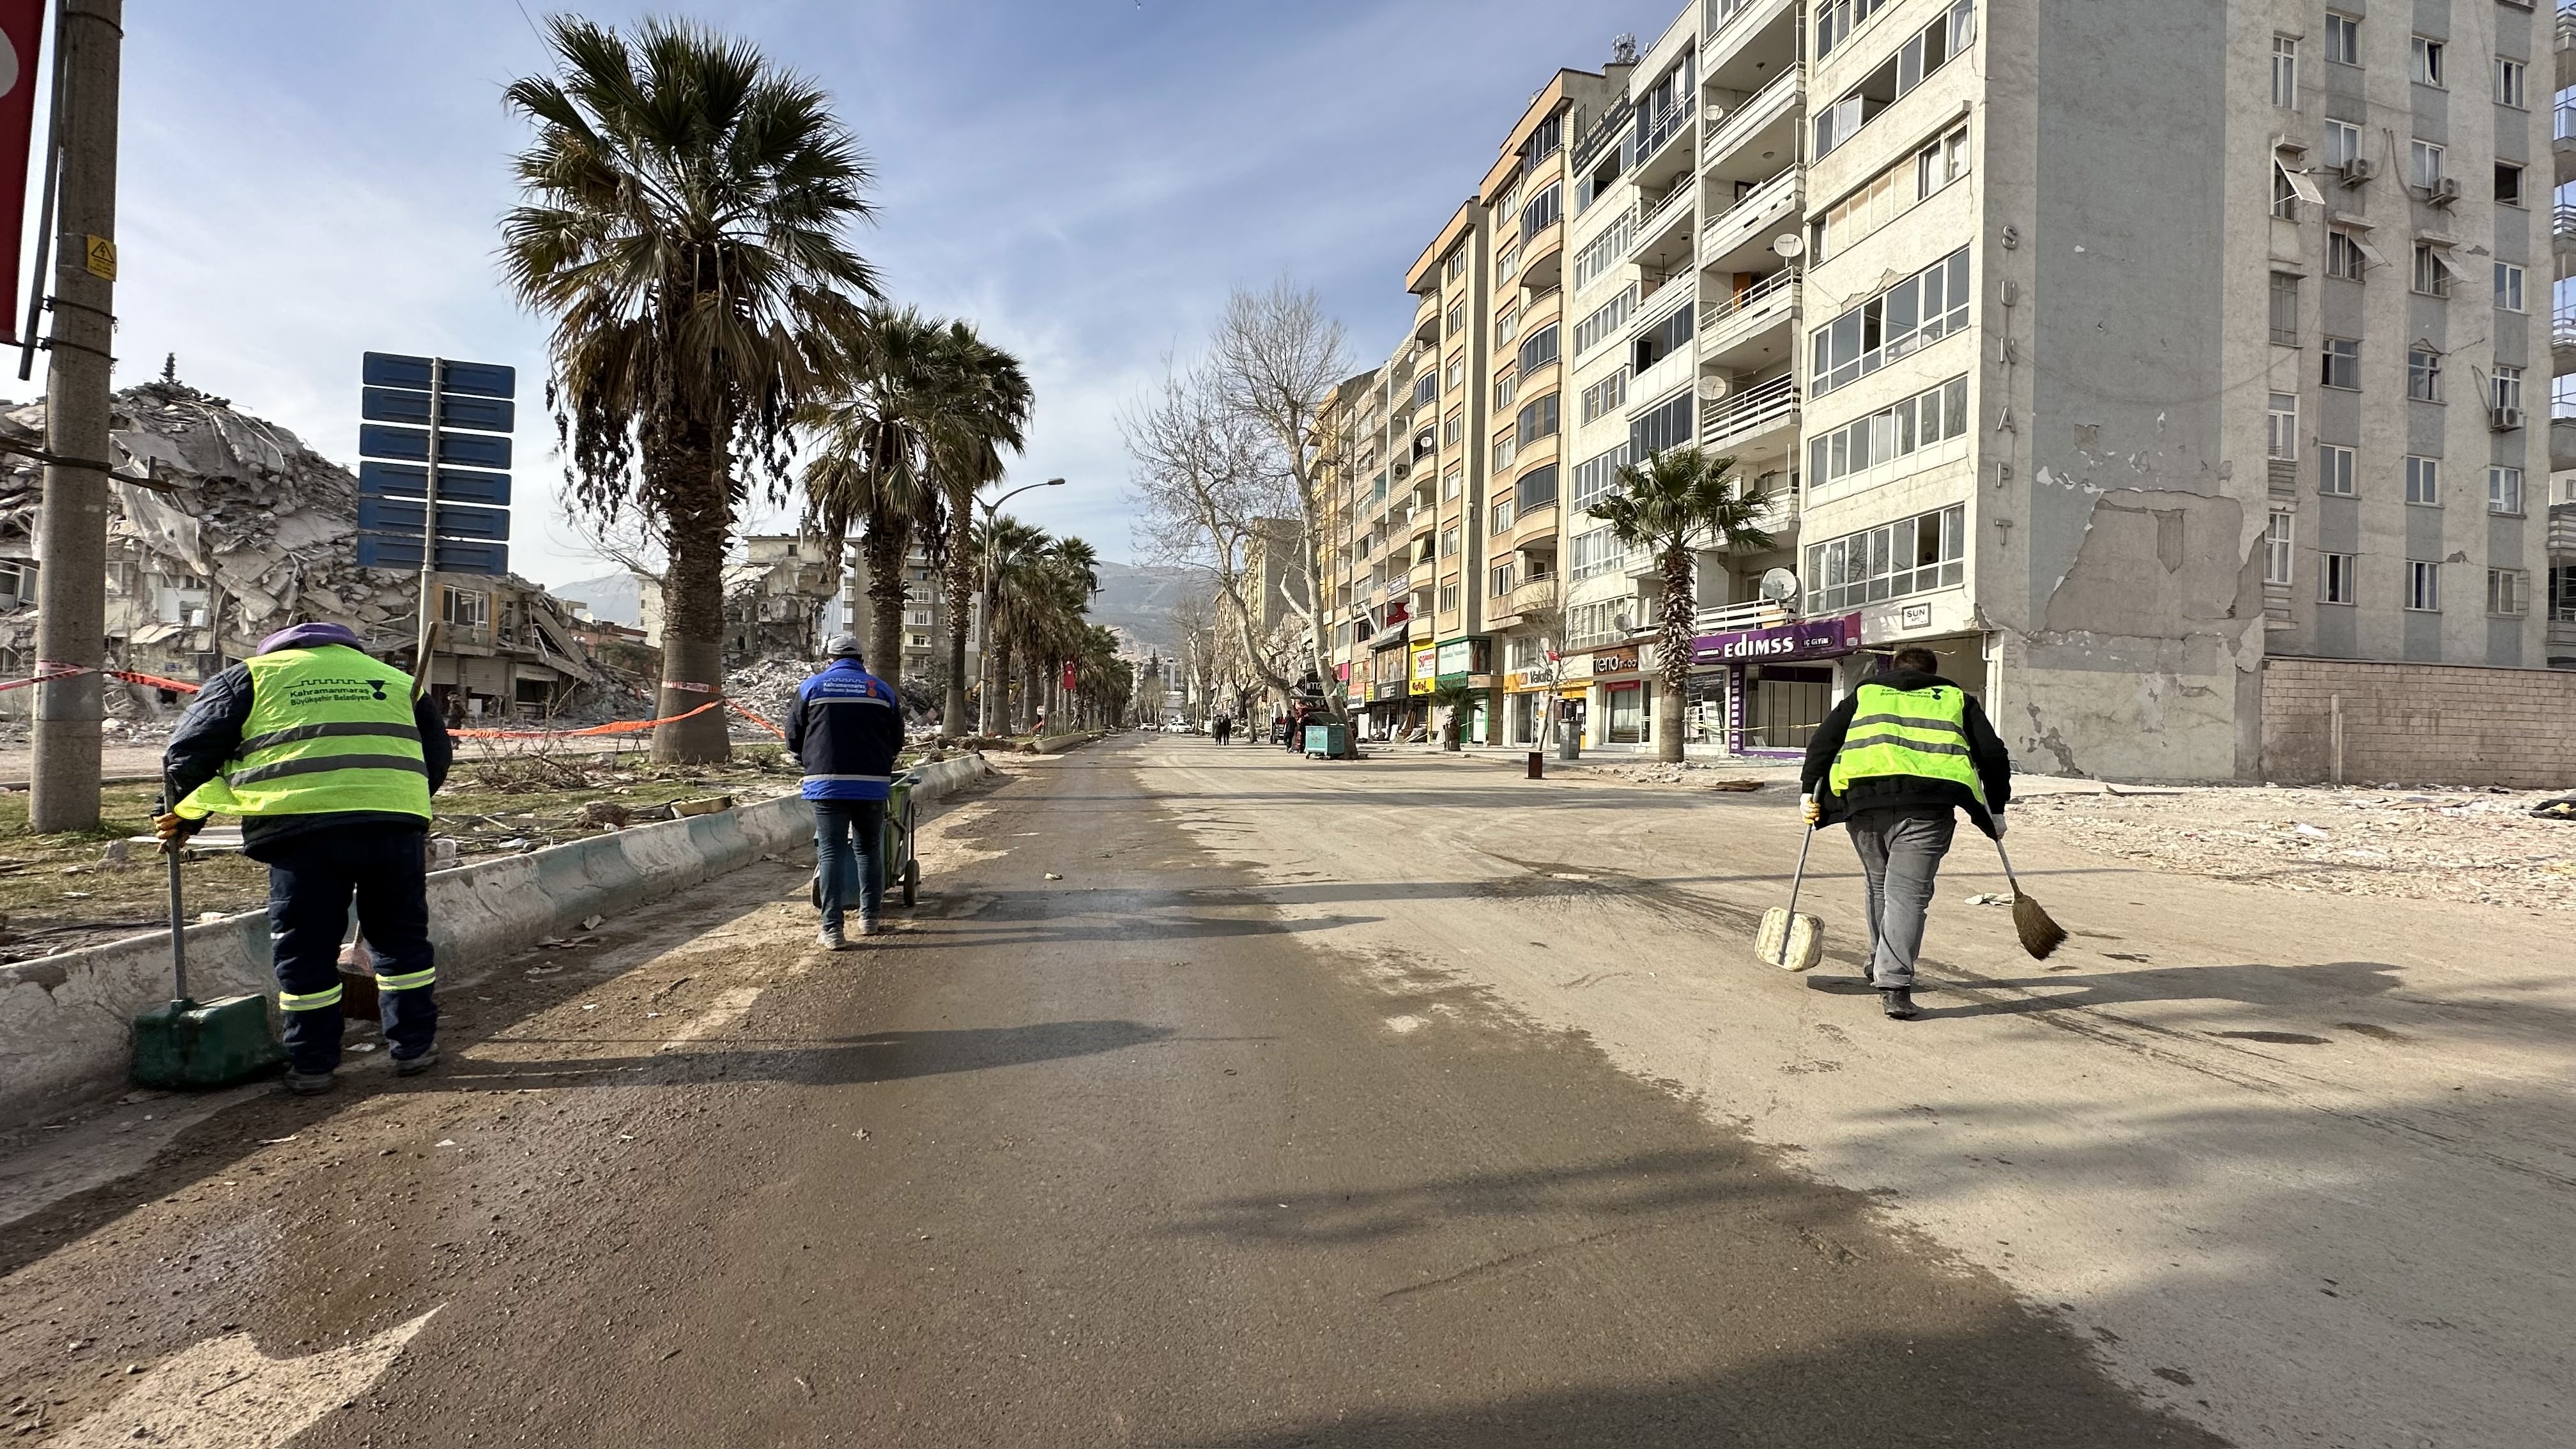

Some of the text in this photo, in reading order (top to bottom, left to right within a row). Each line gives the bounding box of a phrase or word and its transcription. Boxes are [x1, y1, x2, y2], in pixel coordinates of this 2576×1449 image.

[1906, 608, 1925, 618] SUN
[1593, 654, 1619, 671] rend
[290, 688, 369, 698] Kahramanmaraş
[291, 695, 332, 706] Büyükşehir
